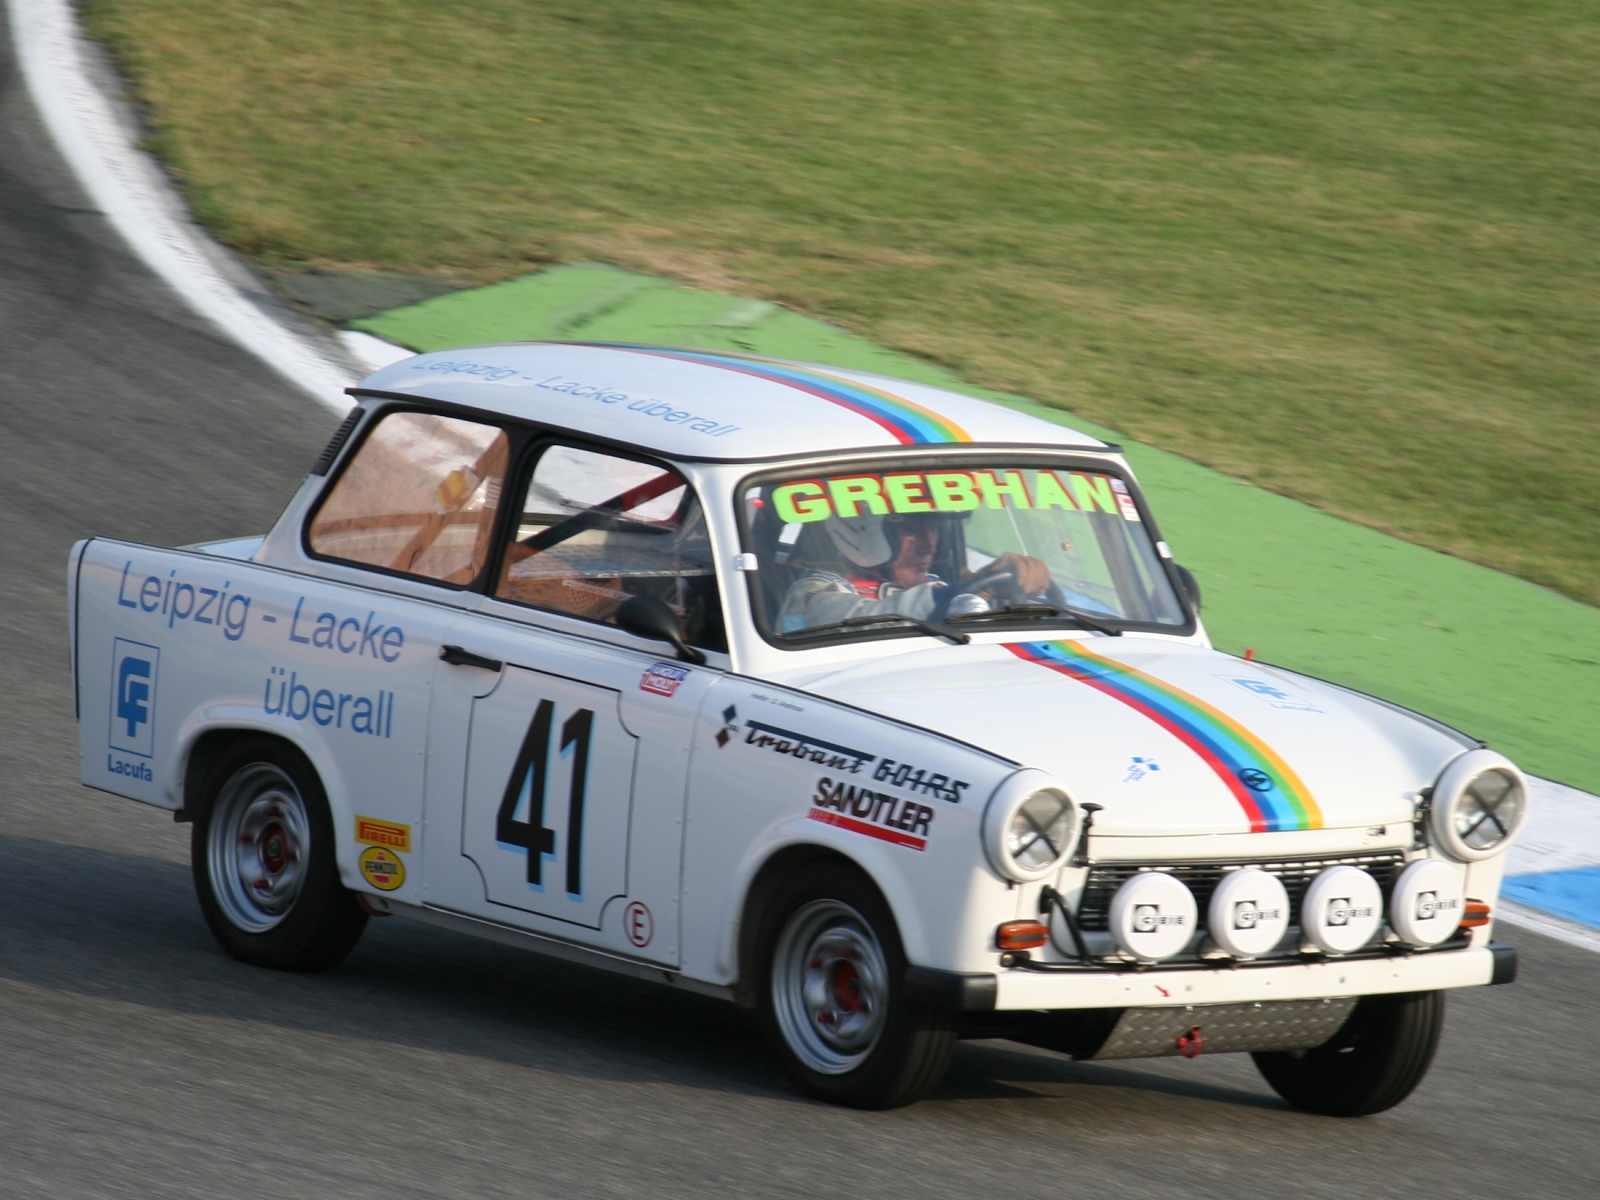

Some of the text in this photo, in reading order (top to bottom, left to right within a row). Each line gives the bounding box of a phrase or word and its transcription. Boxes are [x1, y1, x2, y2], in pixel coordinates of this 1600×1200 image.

[411, 359, 518, 382] Leipzig
[534, 375, 629, 404] Lacke
[627, 396, 742, 438] überall
[771, 468, 1120, 524] GREBHAN
[117, 560, 251, 641] Leipzig
[288, 595, 405, 663] Lacke
[262, 666, 395, 739] überall
[106, 753, 154, 783] Lacufa
[496, 698, 595, 903] 41
[359, 821, 406, 848] PIRELLI
[813, 776, 935, 837] SANDTLER
